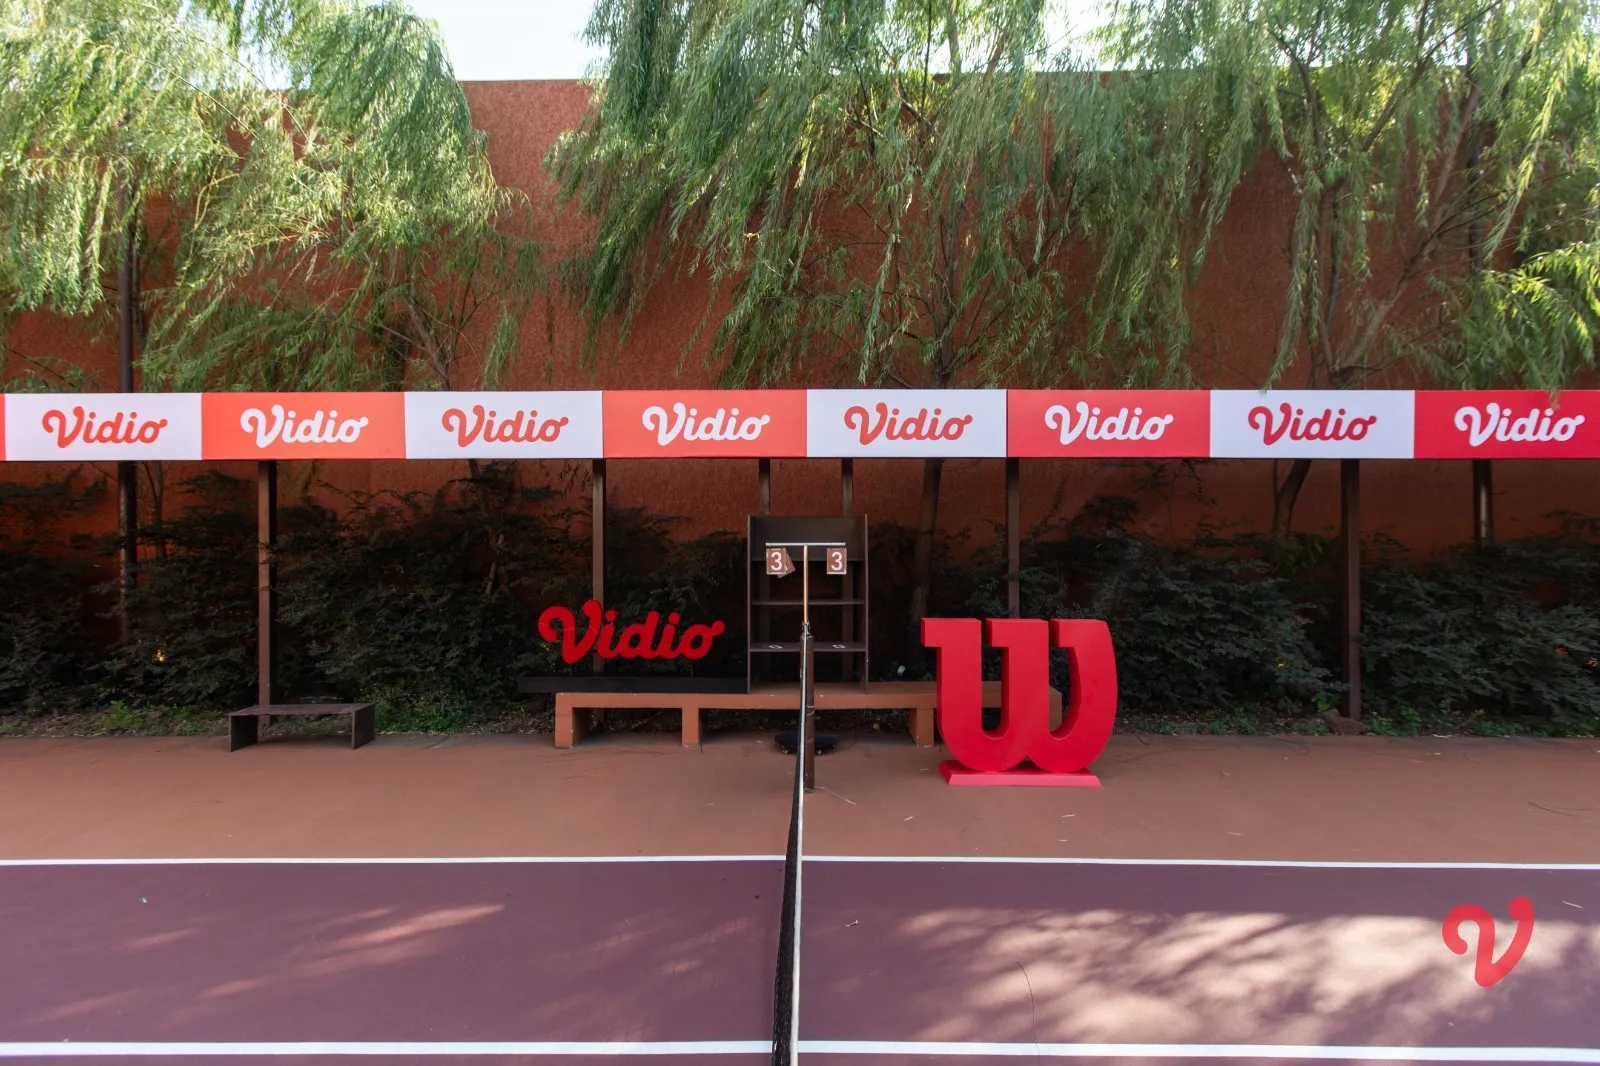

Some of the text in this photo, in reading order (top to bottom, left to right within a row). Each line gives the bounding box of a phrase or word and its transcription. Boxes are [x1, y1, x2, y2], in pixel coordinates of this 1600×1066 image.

[41, 406, 168, 449] Vidio
[239, 403, 369, 449] Vidio
[441, 405, 569, 448] Vidio
[642, 402, 770, 446] Vidio
[844, 402, 972, 445] Vidio
[1045, 402, 1173, 445] Vidio
[1248, 402, 1376, 445] Vidio
[1455, 403, 1585, 446] Vidio
[770, 551, 783, 571] 3
[831, 551, 843, 571] 3
[538, 600, 725, 664] Vidio
